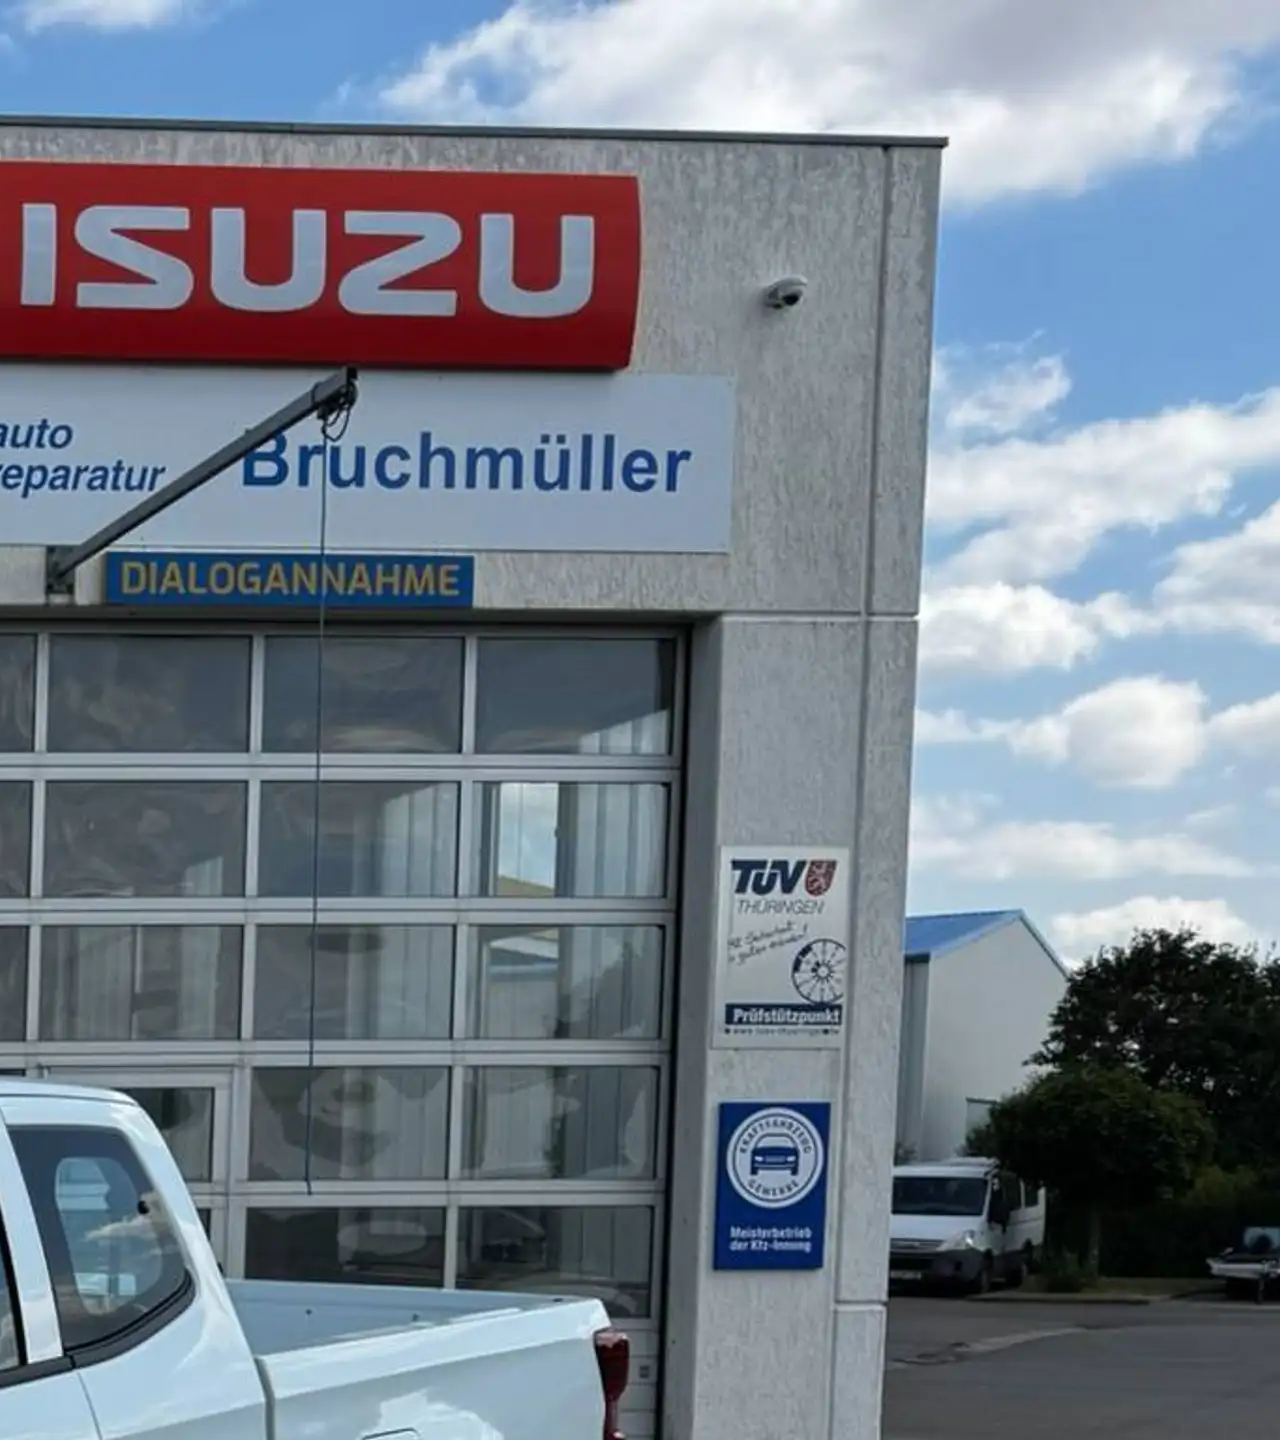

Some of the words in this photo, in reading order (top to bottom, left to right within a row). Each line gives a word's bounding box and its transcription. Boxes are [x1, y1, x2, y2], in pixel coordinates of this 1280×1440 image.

[20, 201, 596, 317] ISUZU
[242, 428, 693, 492] Bruchmüller
[121, 560, 460, 598] DIALOGANNAHME
[733, 1006, 841, 1024] Prüfstützpunkt
